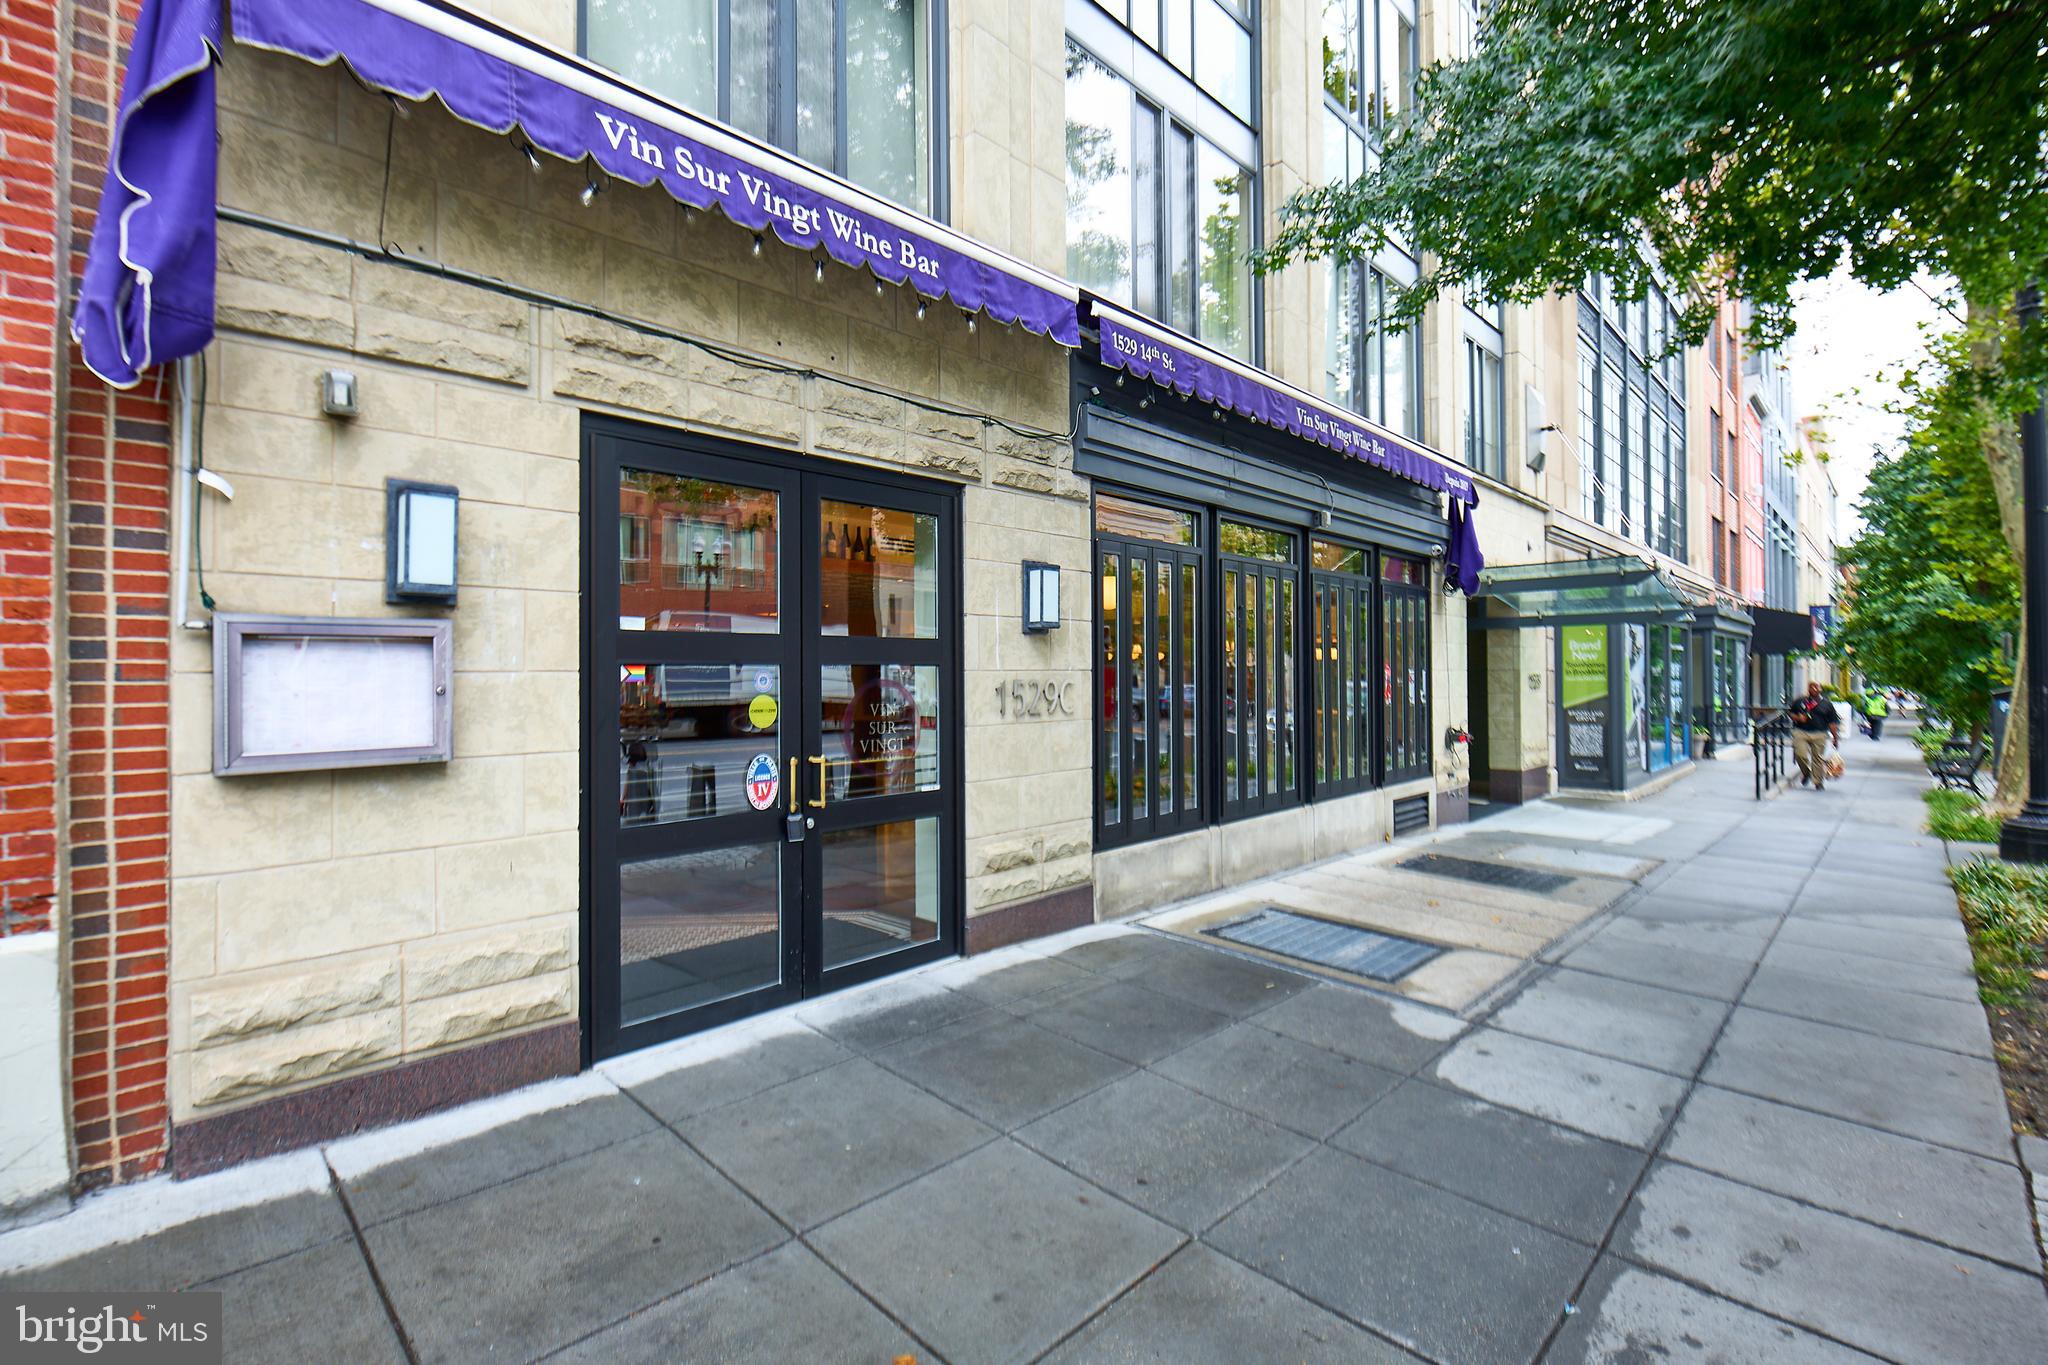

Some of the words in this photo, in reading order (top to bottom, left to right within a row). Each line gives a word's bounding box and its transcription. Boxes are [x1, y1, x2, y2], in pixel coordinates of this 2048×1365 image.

[594, 111, 666, 170] Vin
[674, 145, 731, 195] Sur
[737, 170, 822, 235] Vingt
[826, 206, 893, 259] Wine
[898, 238, 940, 279] Bar
[1111, 331, 1138, 356] 1529
[1140, 343, 1160, 363] 14th
[1162, 352, 1176, 372] St.
[1296, 406, 1314, 428] Vin
[1314, 414, 1329, 434] Sur
[1329, 420, 1352, 447] Vingt
[1352, 430, 1372, 452] Wine
[1372, 438, 1386, 458] Bar
[1569, 639, 1601, 650] Brand
[1571, 650, 1599, 661] New
[995, 679, 1075, 718] 1529C
[870, 703, 896, 717] VIN
[868, 721, 897, 735] SUR
[860, 738, 905, 753] VINGT
[757, 783, 770, 797] IV
